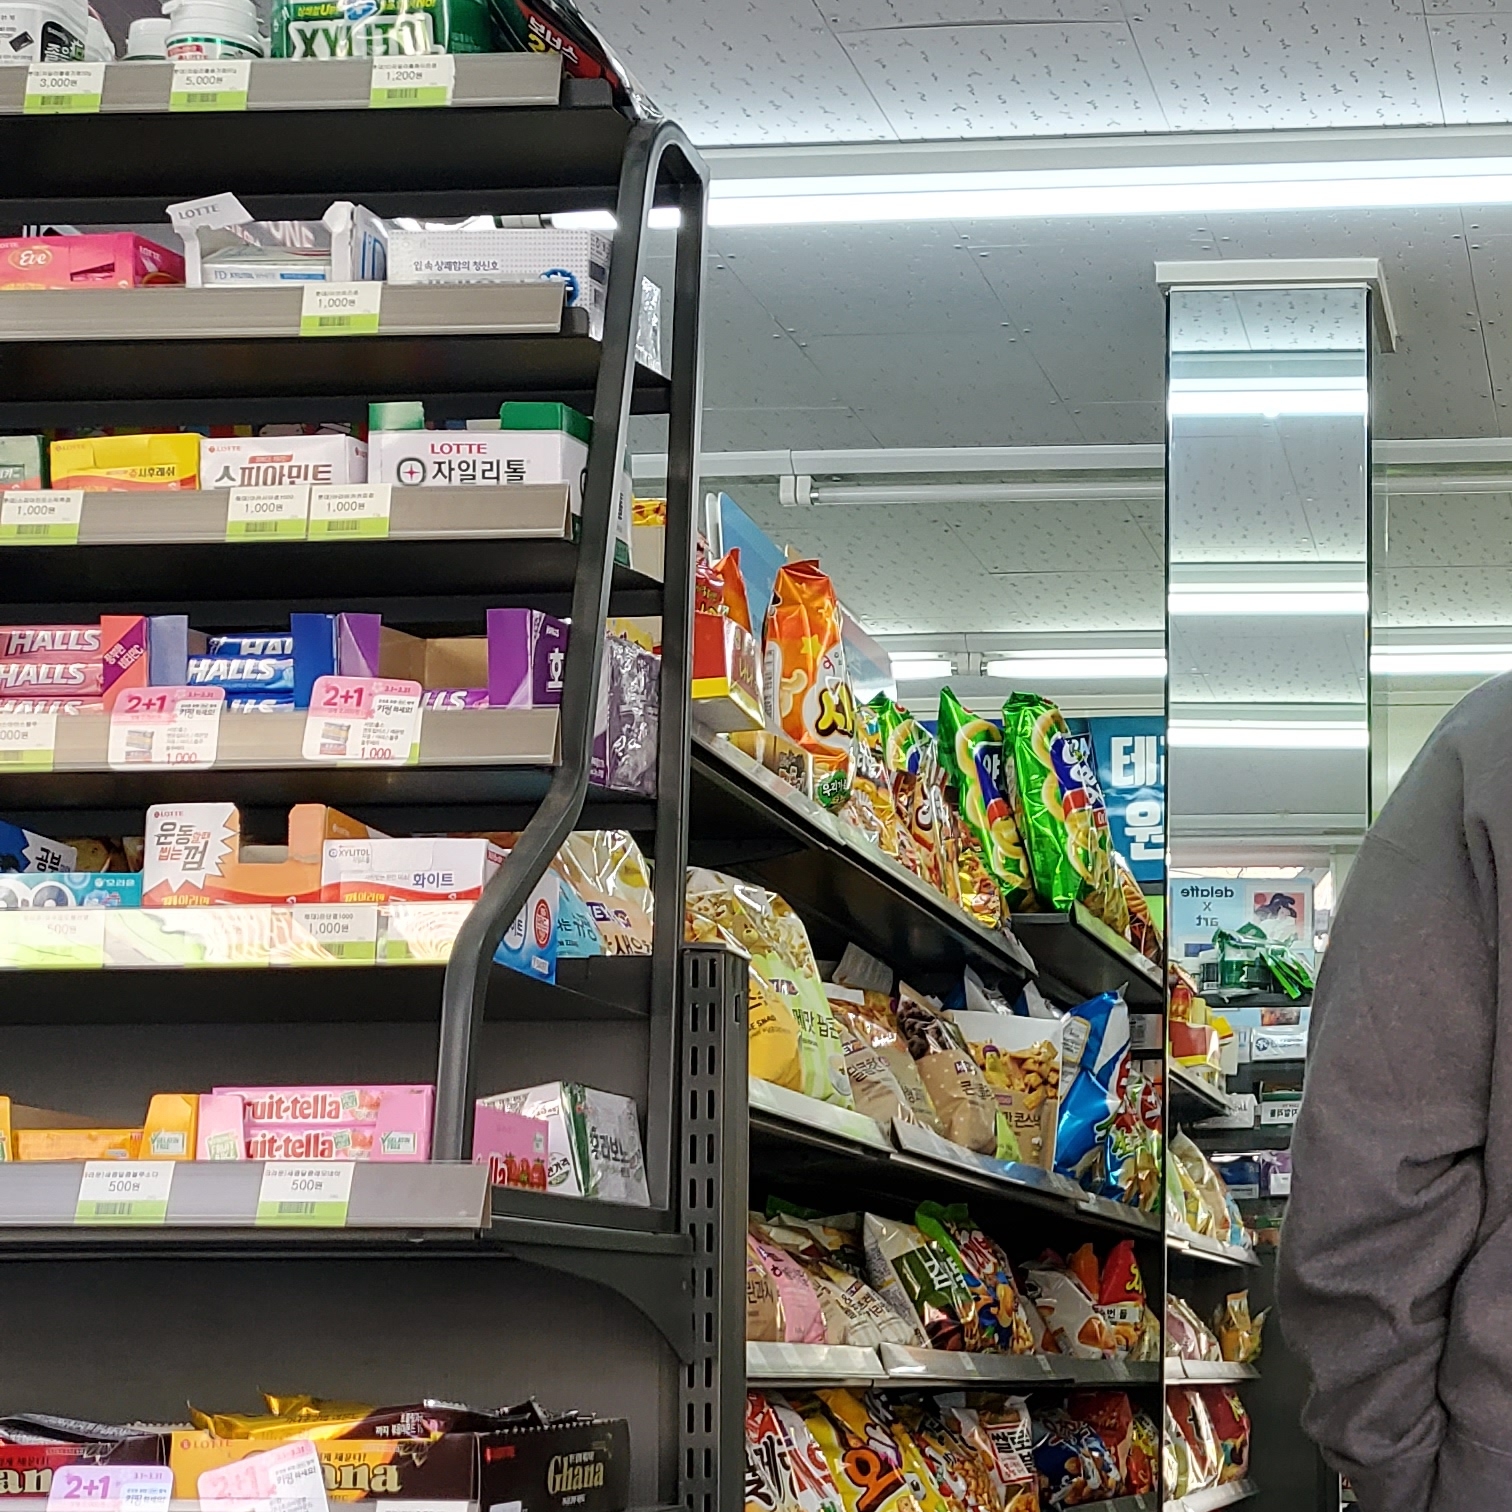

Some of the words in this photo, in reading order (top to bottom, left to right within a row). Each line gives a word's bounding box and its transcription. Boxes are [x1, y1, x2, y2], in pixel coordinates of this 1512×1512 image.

[184, 75, 224, 86] 5,000원
[384, 70, 424, 81] 1,200원
[39, 77, 78, 88] 3,000원
[178, 203, 220, 221] LOTTE
[18, 249, 48, 266] Eve
[317, 297, 357, 309] 1,000원
[430, 443, 488, 455] LOTTE
[213, 463, 333, 486] 스피아민트
[431, 459, 527, 484] 자일리톨
[16, 505, 56, 516] 1,000원
[243, 503, 284, 514] 1,000원
[326, 501, 366, 513] 1,000원
[9, 630, 101, 653] HALLS
[187, 658, 278, 683] HALLS
[322, 686, 364, 708] 2+1
[125, 695, 168, 714] 2+1
[360, 748, 393, 761] 1,000
[154, 810, 184, 818] LOTTE
[155, 821, 196, 846] 운동
[181, 843, 209, 872] 껌
[339, 848, 372, 858] XYLITOL
[411, 871, 455, 889] 화이트
[308, 922, 350, 935] 1,000원
[108, 1180, 141, 1192] 500원
[291, 1178, 324, 1191] 500원
[547, 1452, 606, 1495] Ghana
[64, 1475, 111, 1500] 2+1
